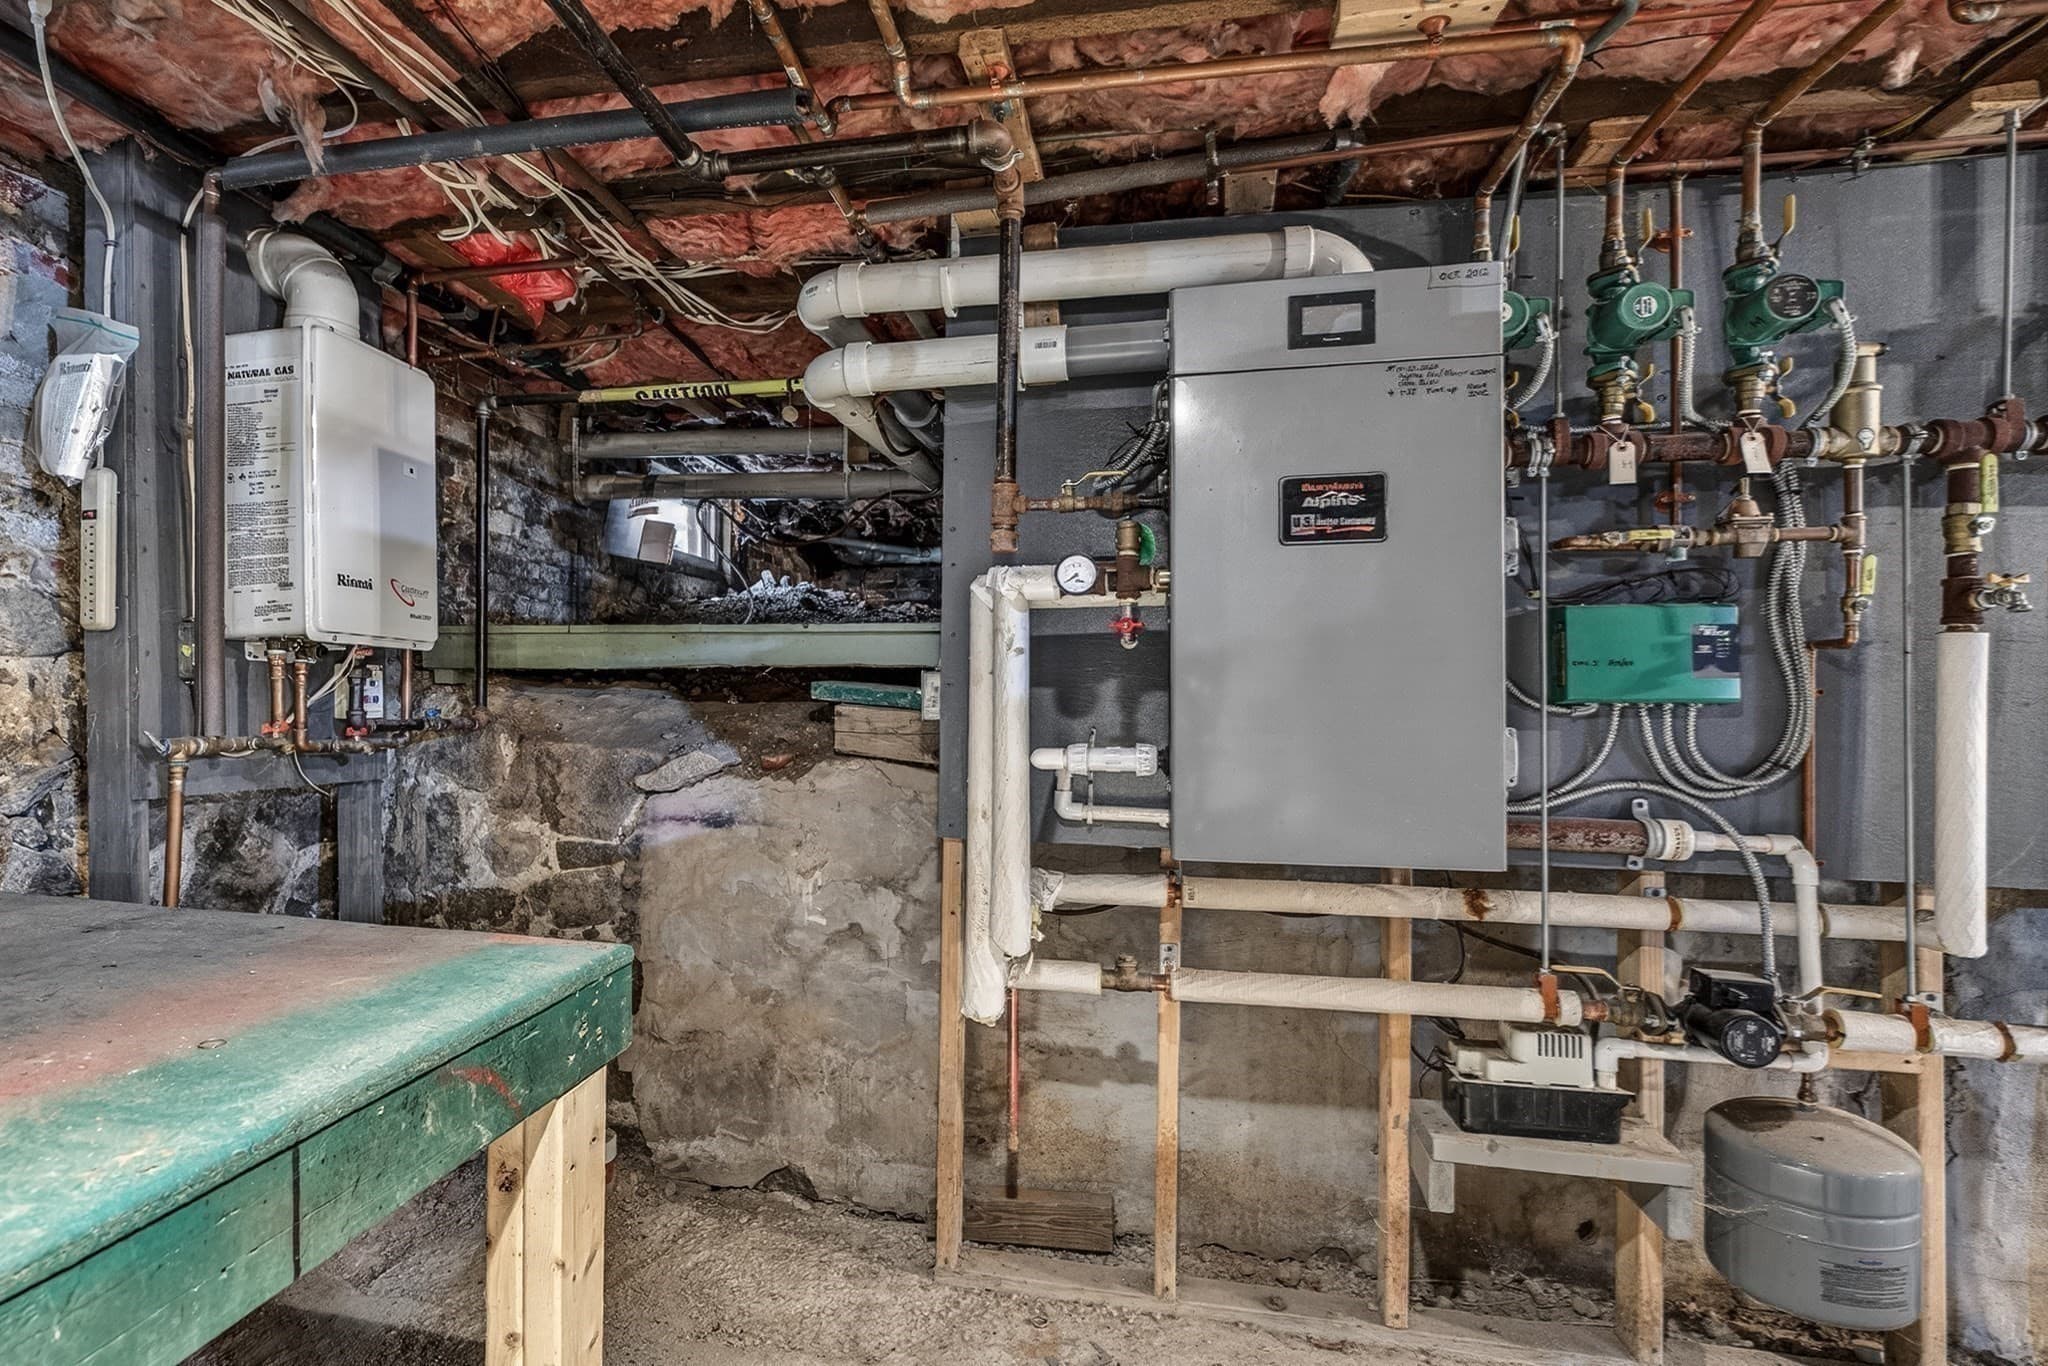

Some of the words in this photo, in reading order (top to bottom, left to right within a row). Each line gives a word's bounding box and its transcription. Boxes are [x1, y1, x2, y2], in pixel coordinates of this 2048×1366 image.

[227, 368, 271, 380] NATURAL
[274, 365, 294, 376] GAS
[1301, 495, 1361, 508] Alpine
